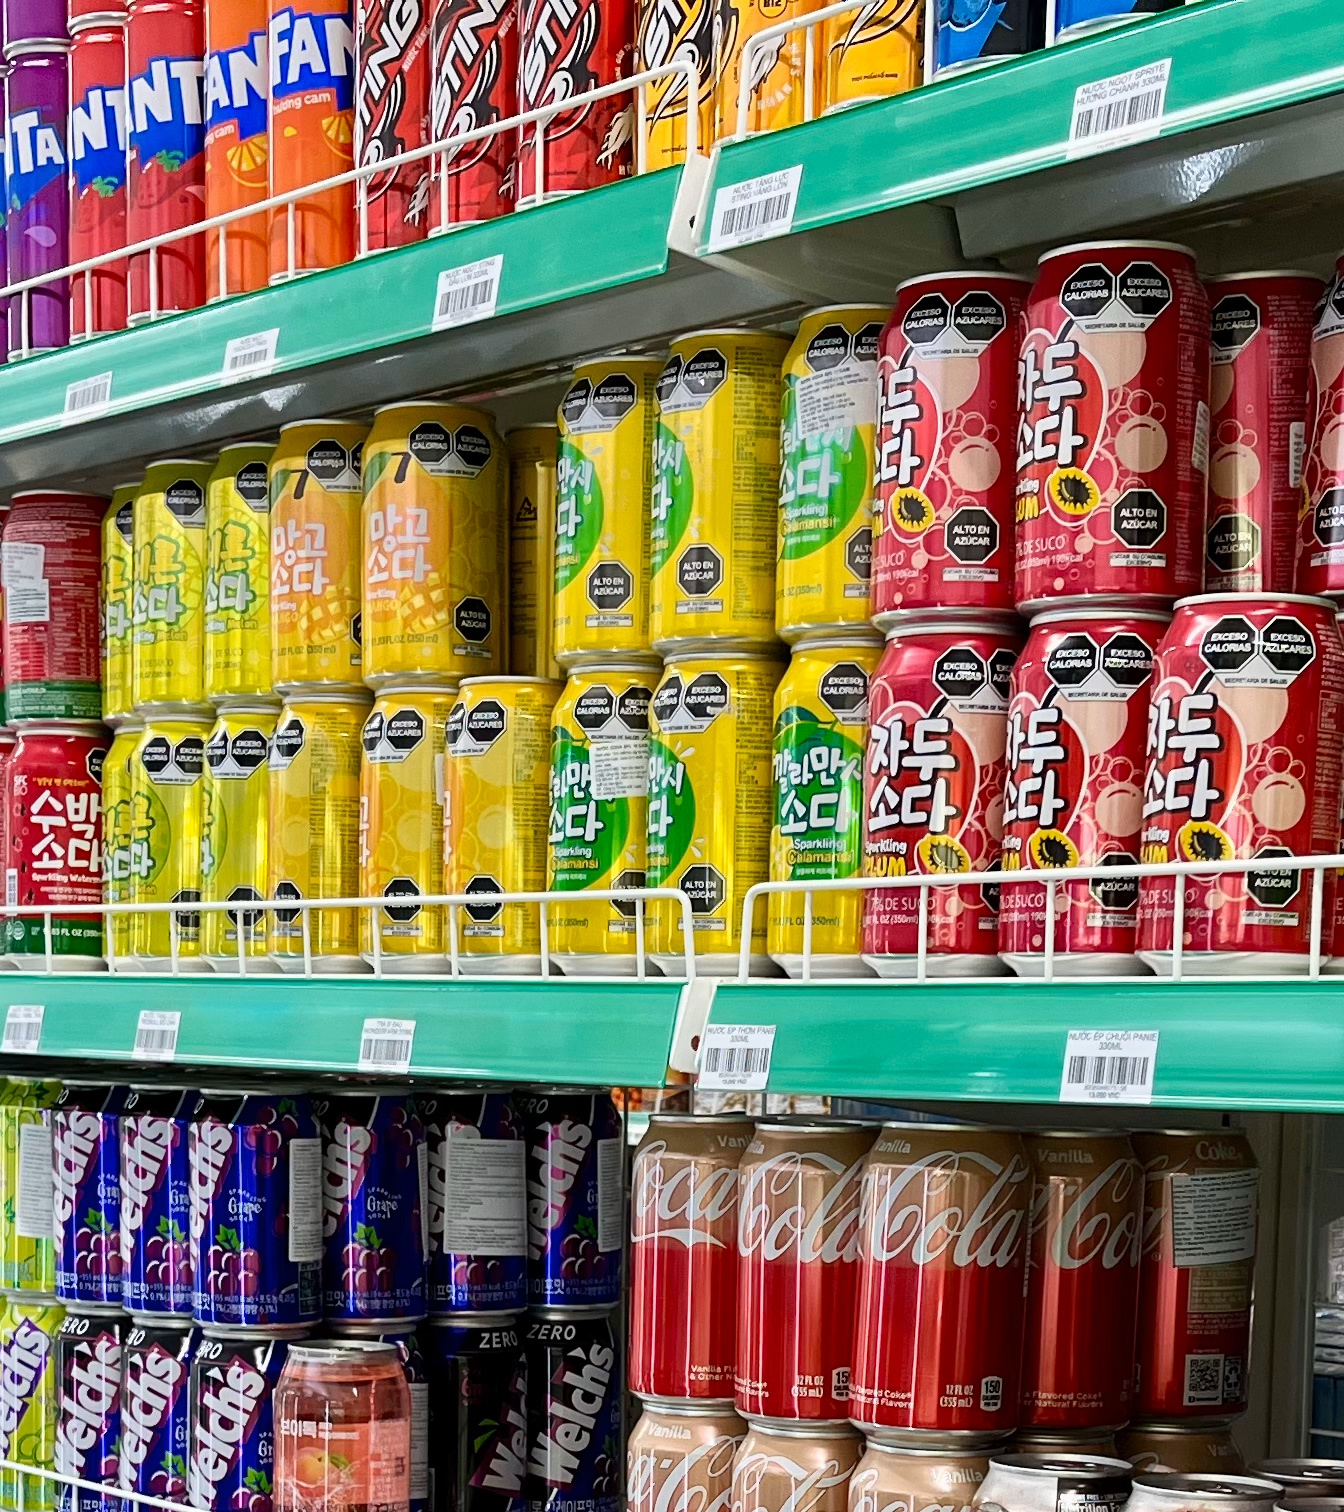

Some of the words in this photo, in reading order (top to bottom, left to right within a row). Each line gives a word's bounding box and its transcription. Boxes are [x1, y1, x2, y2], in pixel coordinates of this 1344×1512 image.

[1064, 288, 1109, 300] CALORIAS
[1121, 286, 1168, 298] AZUCARES
[905, 317, 944, 329] CALORIAS
[1120, 508, 1141, 519] ALTO
[369, 503, 431, 552] 망고
[953, 525, 974, 536] ALTO
[977, 525, 990, 535] EN
[1120, 517, 1158, 530] AZÚCAR
[954, 535, 990, 547] AZÚCAR
[367, 544, 432, 584] 소다
[683, 561, 701, 571] ALTO
[1204, 640, 1252, 654] CALORIAS
[870, 717, 955, 778] 자두
[868, 779, 956, 832] 소다
[30, 790, 103, 838] 수박
[1039, 1149, 1094, 1164] Vanilla
[873, 1151, 1031, 1267] Cola
[480, 1331, 518, 1349] ZERO
[526, 1324, 576, 1341] ZERO
[984, 1379, 1001, 1394] 150
[528, 1342, 614, 1484] Welch's
